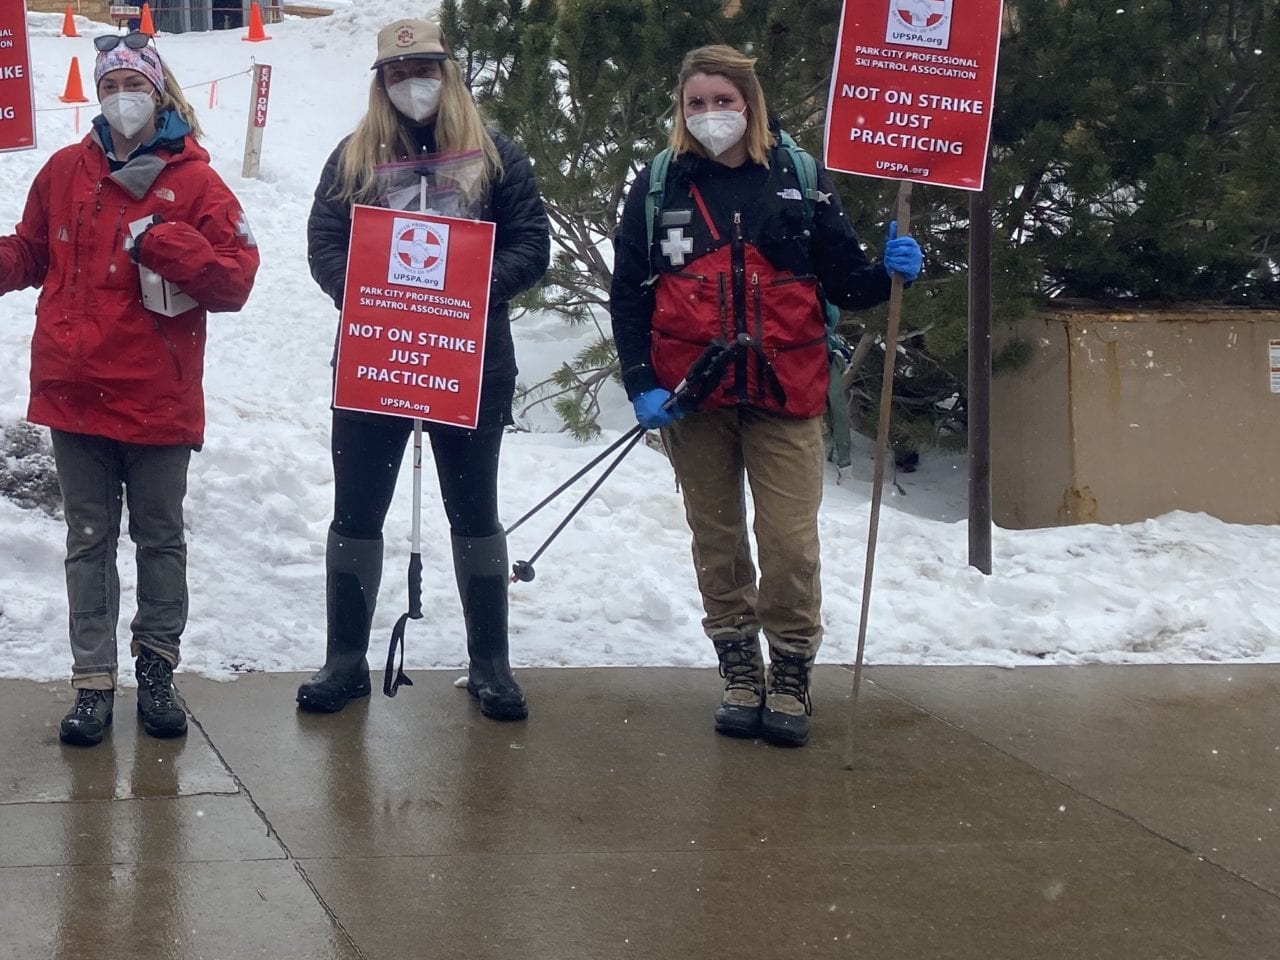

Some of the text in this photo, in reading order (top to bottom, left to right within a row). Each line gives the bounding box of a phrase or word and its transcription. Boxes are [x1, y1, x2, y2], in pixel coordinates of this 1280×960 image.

[892, 31, 943, 46] UPSPA.org
[855, 45, 979, 68] PARK CITY PROFESSIONAL
[855, 57, 977, 80] SKI PATROL ASSOCIATION
[256, 67, 269, 124] EXIT ONLY
[842, 84, 983, 115] NOT ON STRIKE
[885, 111, 932, 129] JUST
[850, 127, 963, 155] PRACTICING
[876, 161, 929, 176] UPSPA.org
[393, 273, 439, 286] UPSPA.org
[360, 286, 472, 309] PARK CITY PROFESSIONAL
[360, 297, 470, 320] SKI PATROL ASSOCIATION
[348, 323, 476, 354] NOT ON STRIKE
[389, 349, 431, 367] JUST
[357, 365, 459, 393] PRACTICING
[380, 397, 430, 414] UPSPA.org
